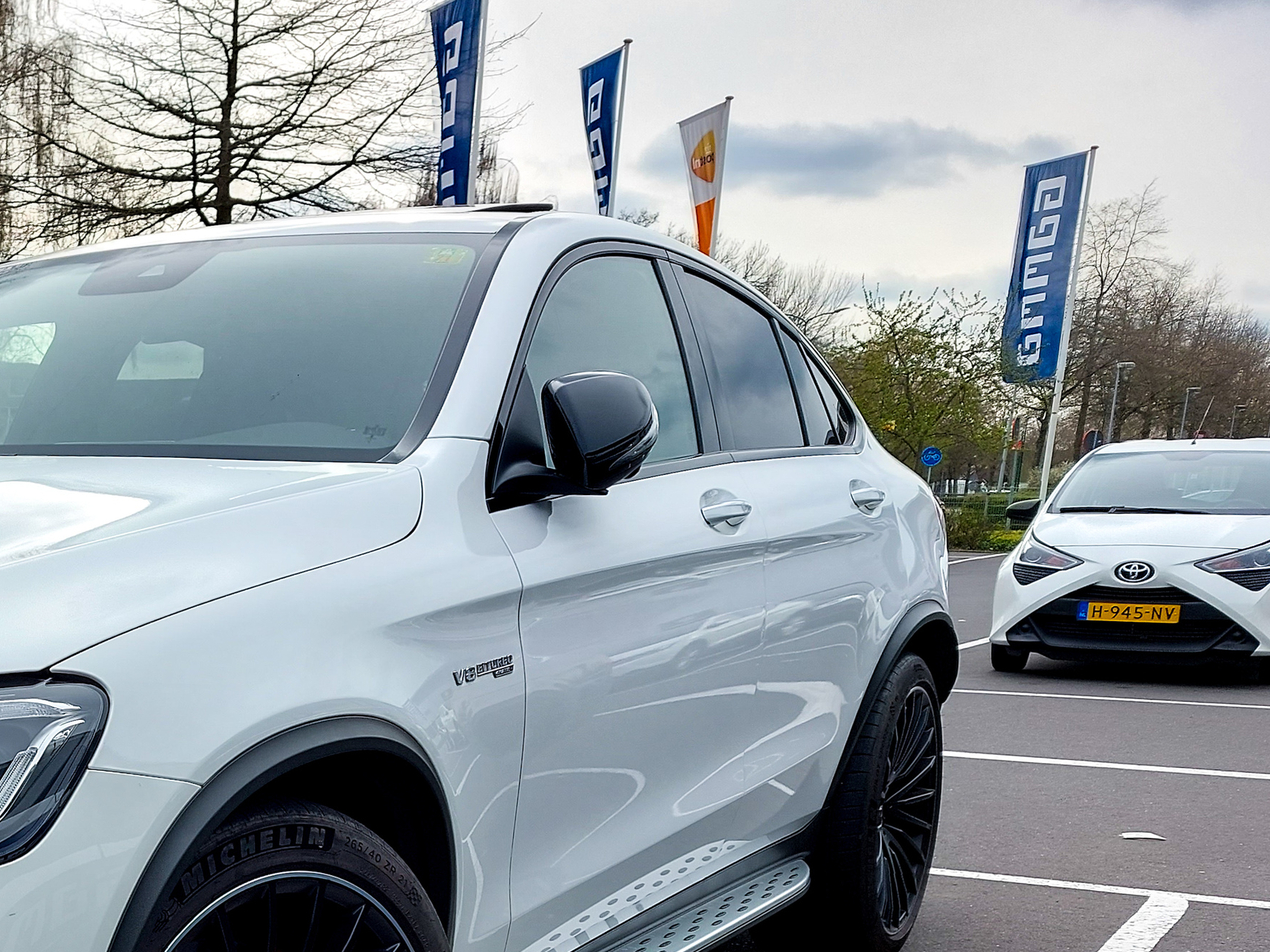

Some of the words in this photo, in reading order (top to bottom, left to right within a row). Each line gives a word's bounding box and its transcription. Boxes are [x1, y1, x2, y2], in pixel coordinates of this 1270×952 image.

[1092, 605, 1175, 620] H-945-NV
[181, 826, 326, 896] MICHELIN
[344, 836, 382, 863] 265/40
[383, 859, 397, 875] ZR
